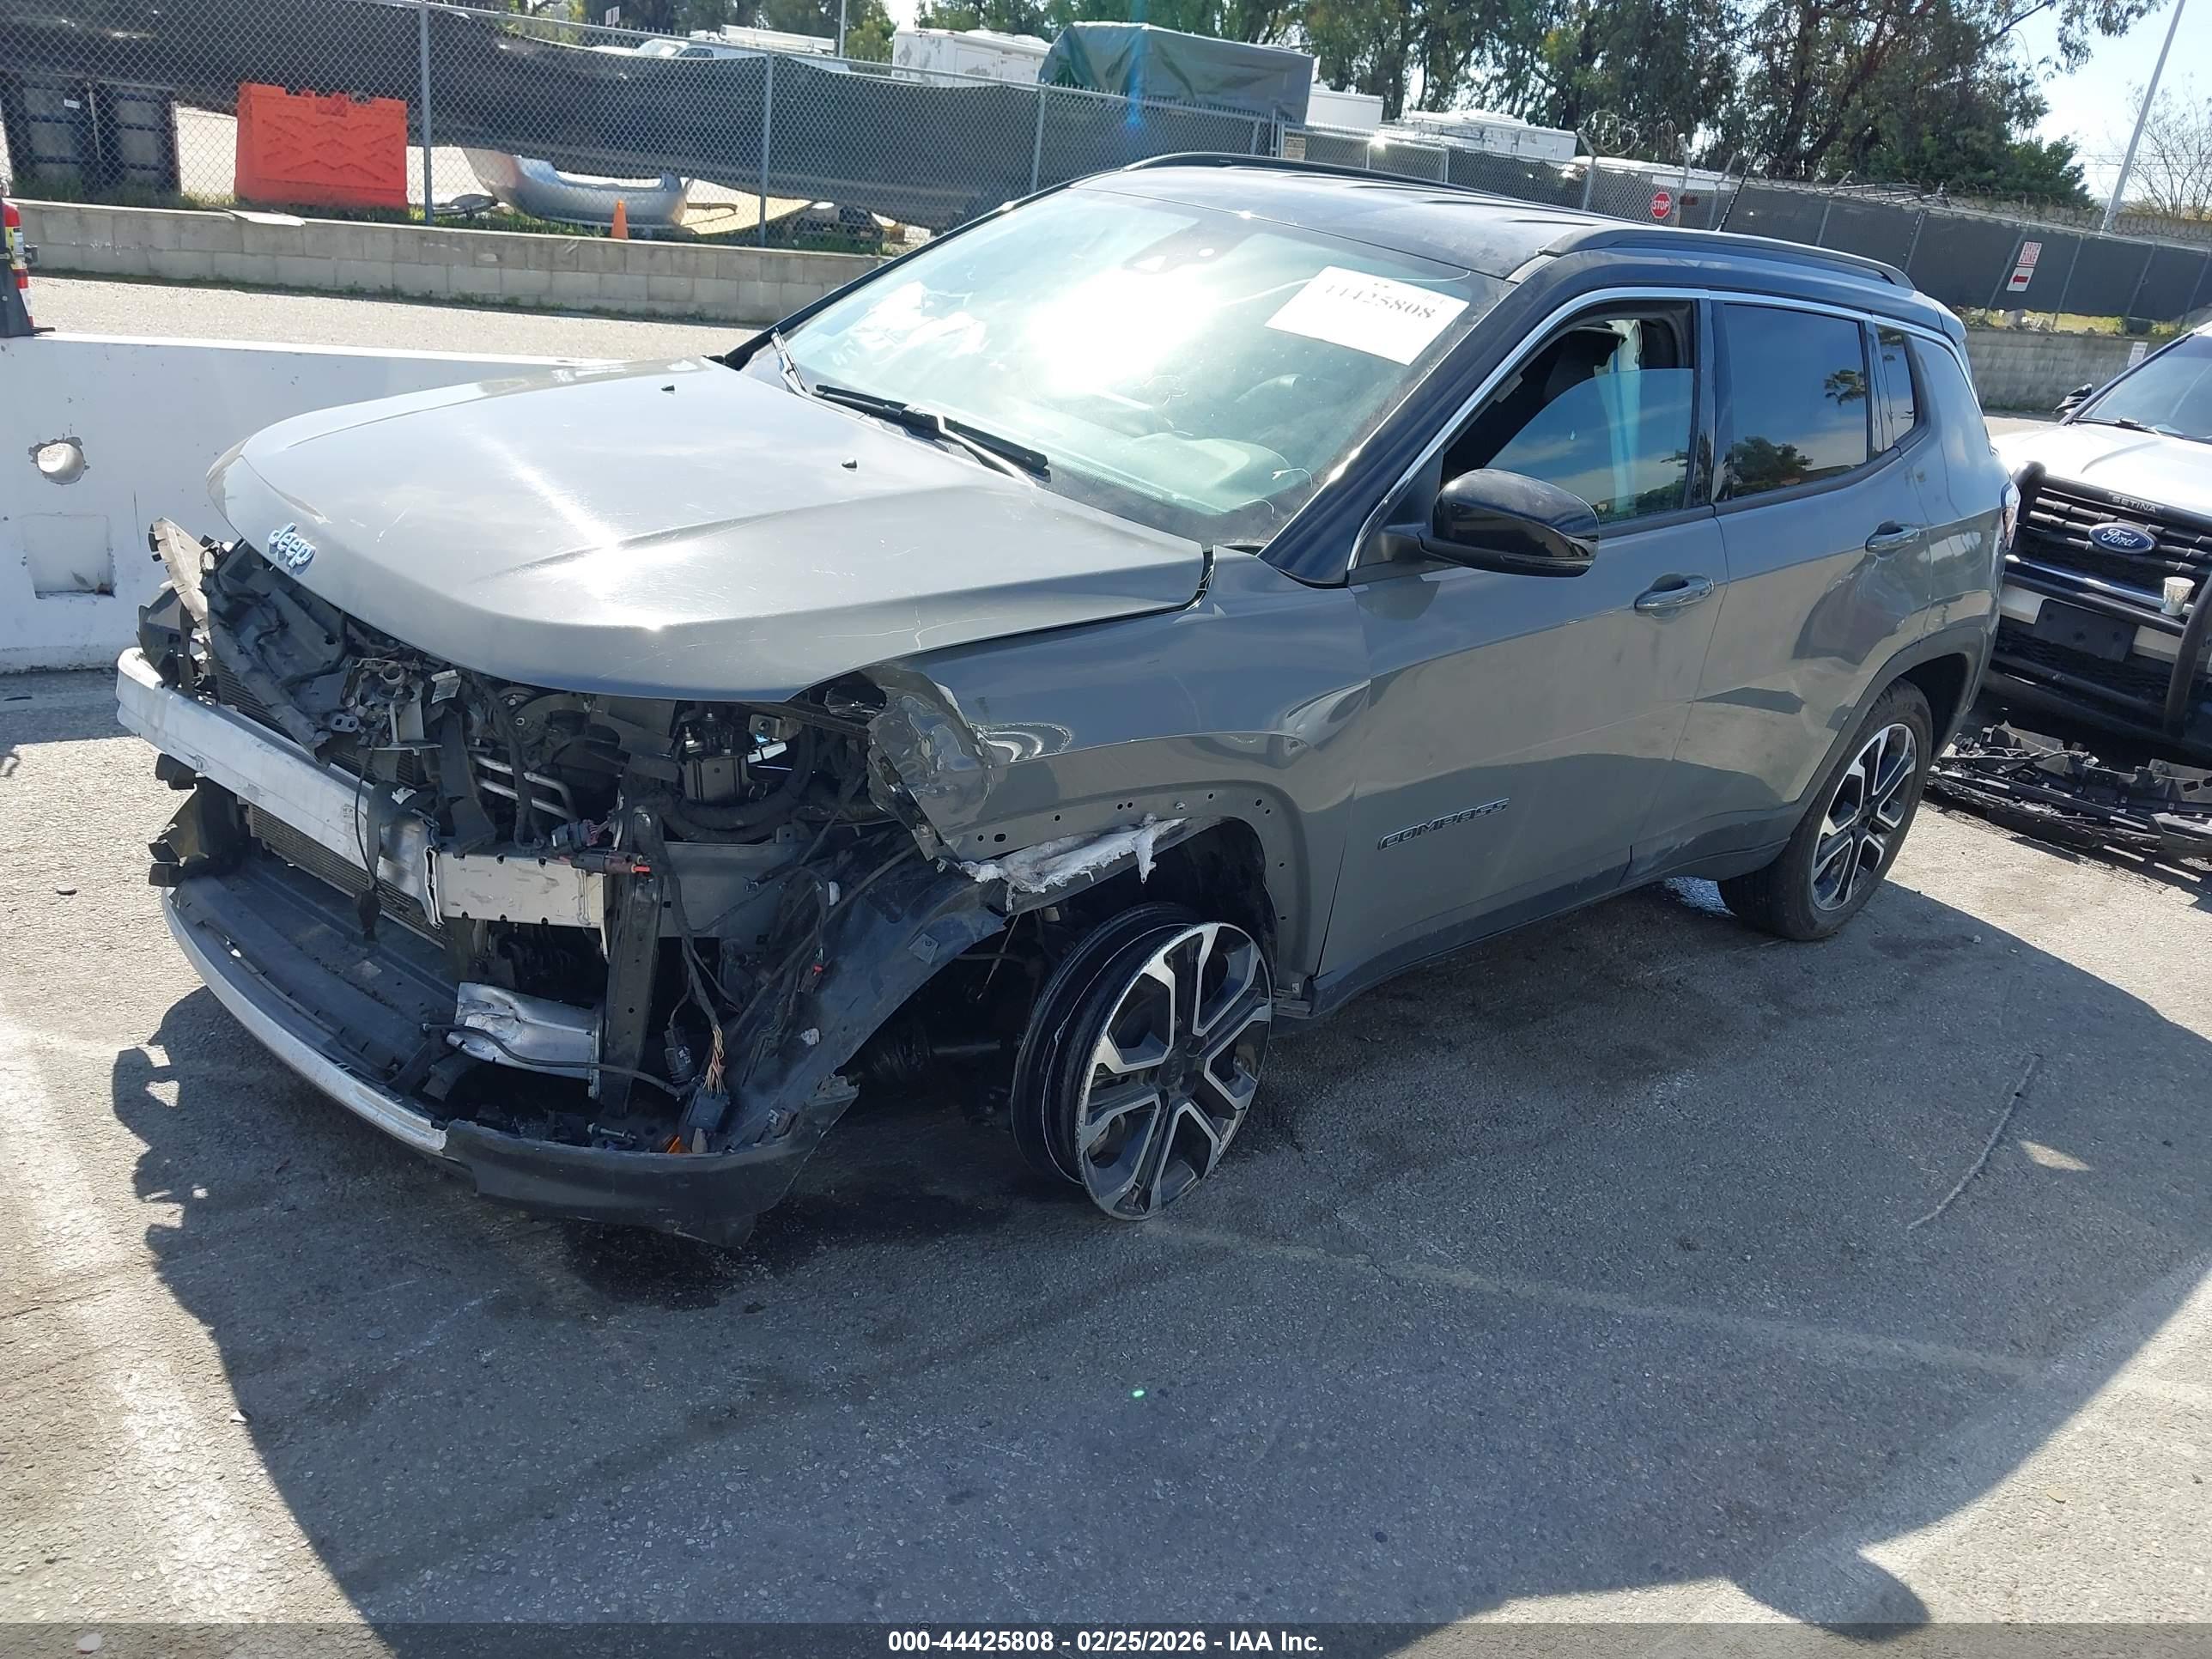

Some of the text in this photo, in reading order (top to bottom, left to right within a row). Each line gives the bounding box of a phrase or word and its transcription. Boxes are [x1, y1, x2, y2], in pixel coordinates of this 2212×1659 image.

[1652, 200, 1670, 210] STOP
[2112, 495, 2157, 514] SETINA
[268, 522, 316, 568] Jeep
[2101, 528, 2138, 547] Ford
[1377, 798, 1510, 851] COMPASS
